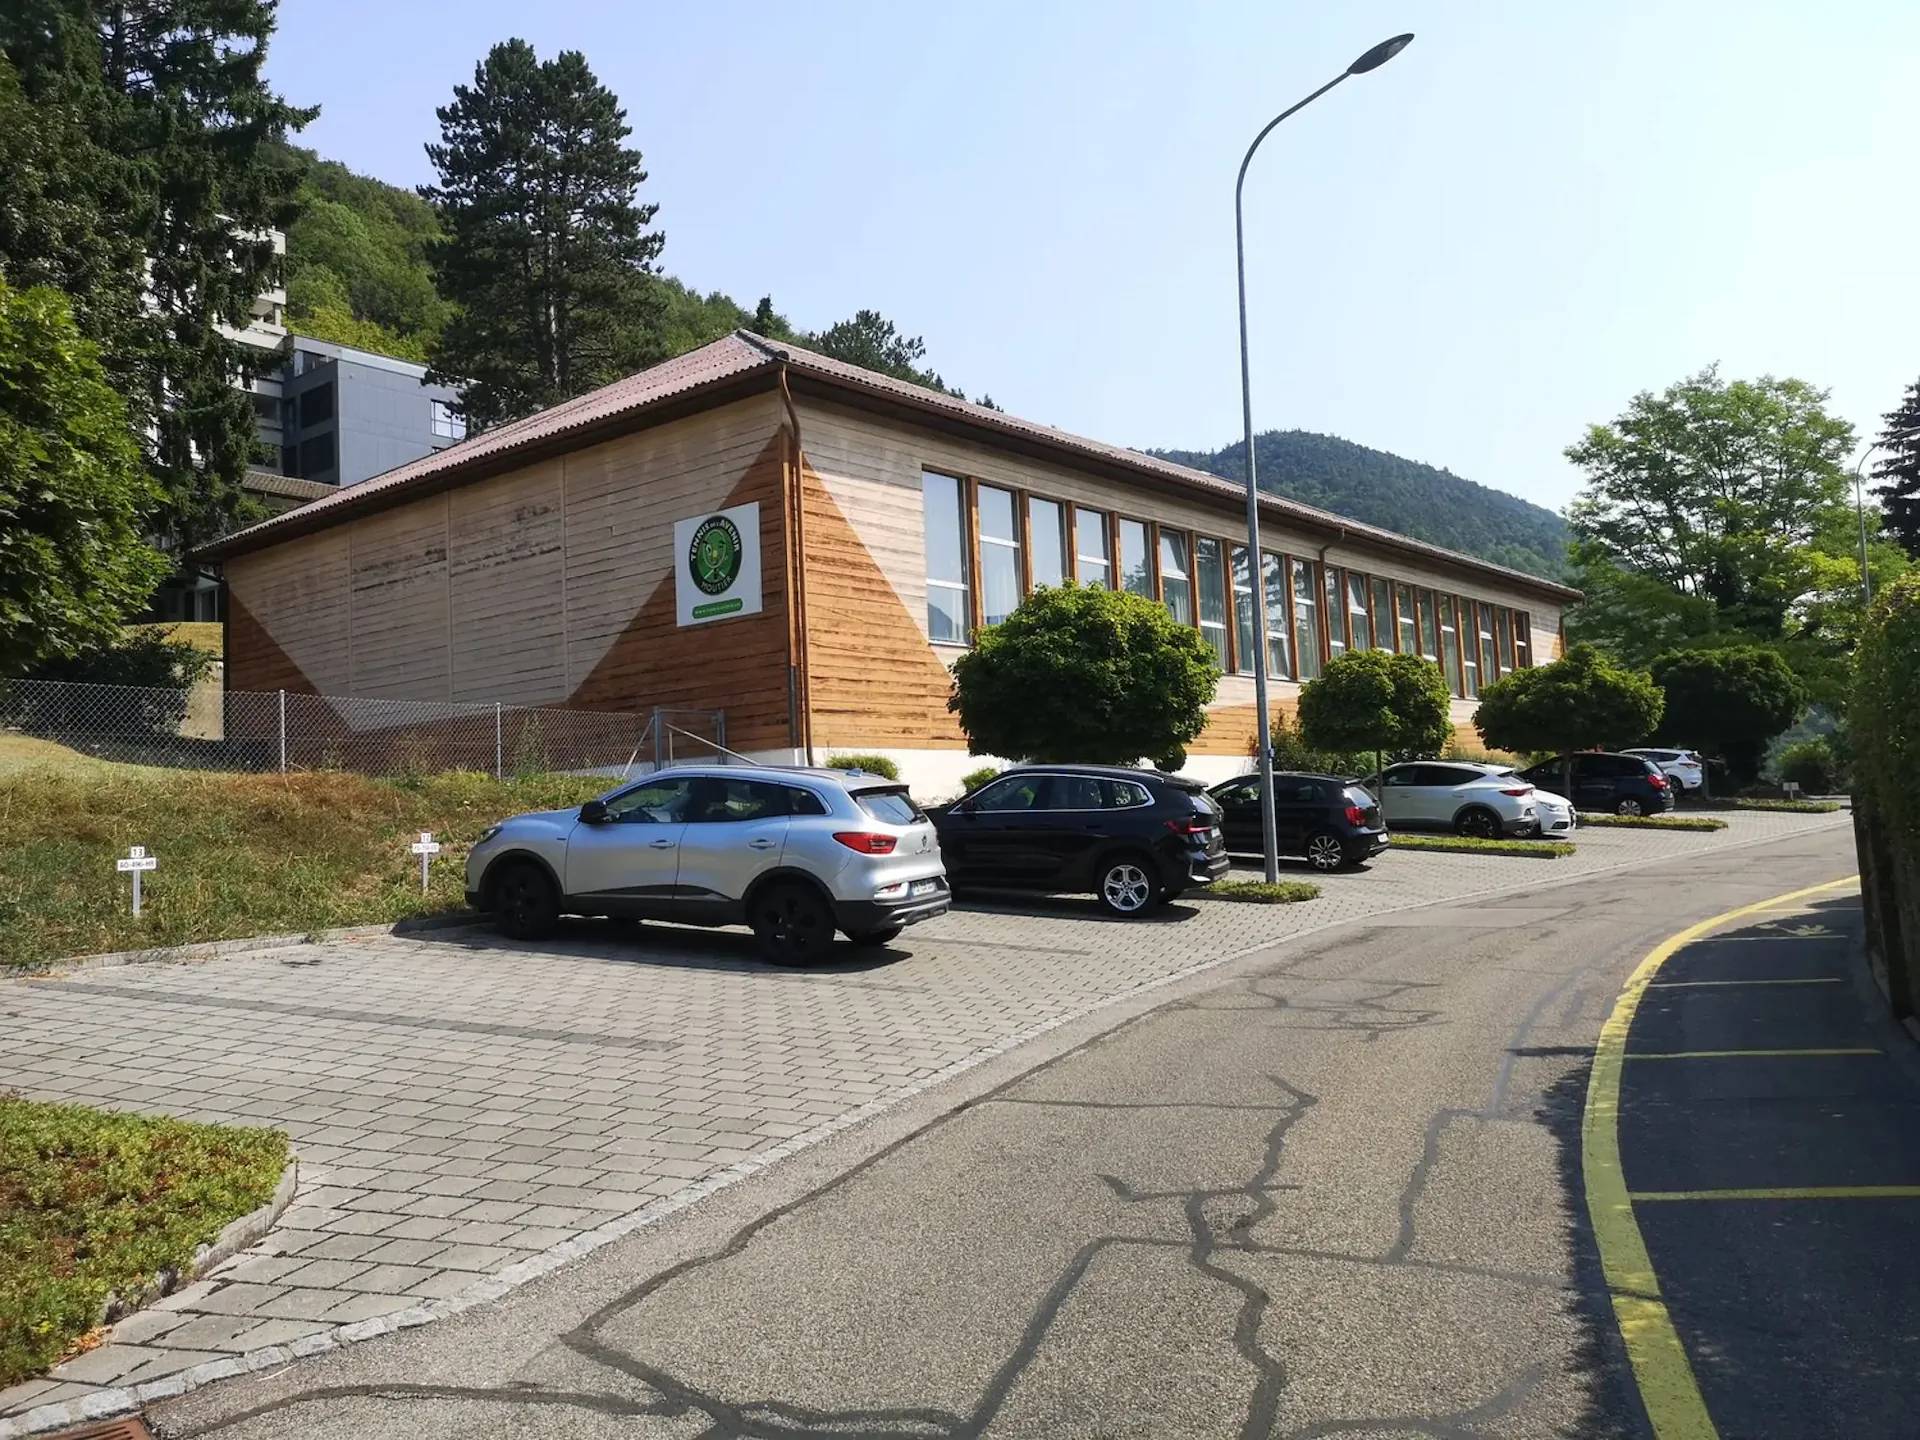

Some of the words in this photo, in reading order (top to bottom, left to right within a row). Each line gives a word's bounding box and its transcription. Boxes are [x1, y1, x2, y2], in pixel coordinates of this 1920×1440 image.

[691, 522, 710, 562] TENNIS
[701, 575, 732, 593] MOUTIER
[133, 848, 143, 857] 13
